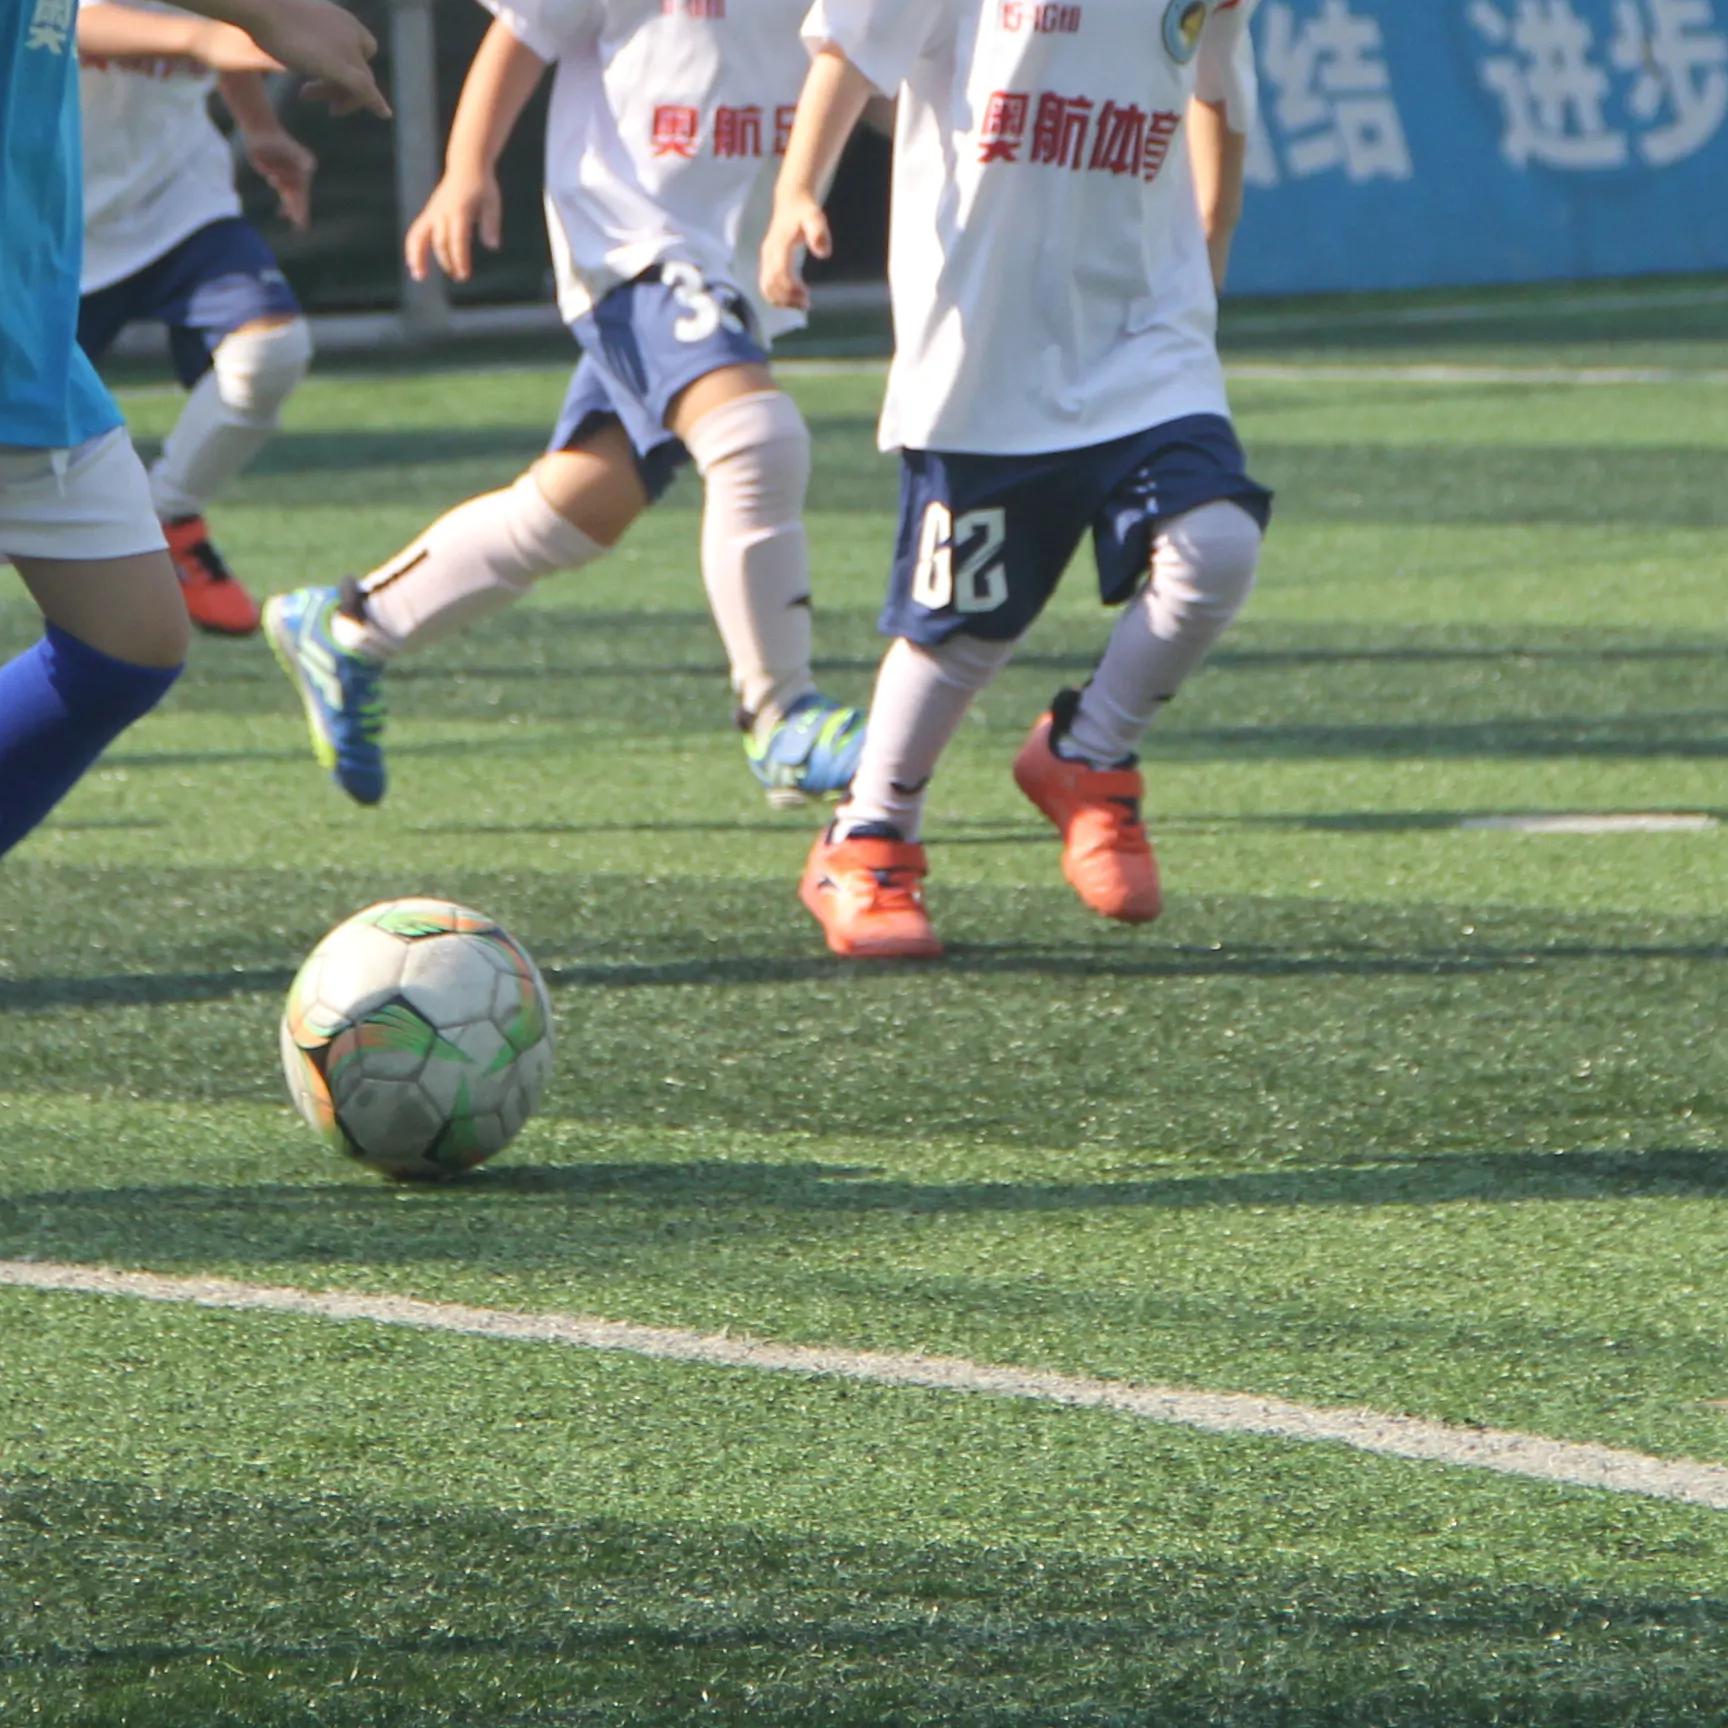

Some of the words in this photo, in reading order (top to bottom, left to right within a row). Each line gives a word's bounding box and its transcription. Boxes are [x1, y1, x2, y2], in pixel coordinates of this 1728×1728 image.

[977, 90, 1182, 185] 奥航体育
[912, 501, 1009, 613] 62
